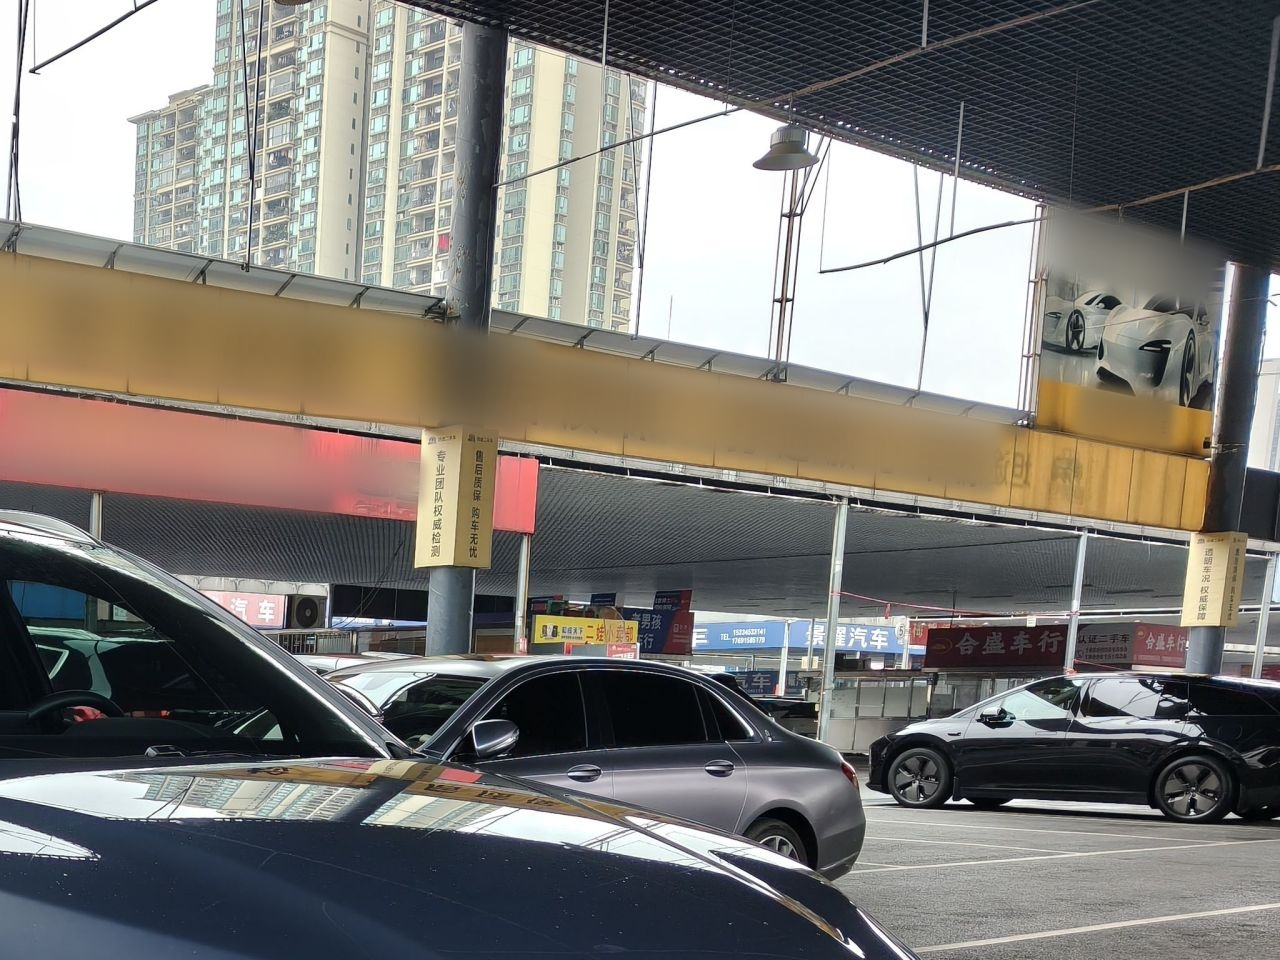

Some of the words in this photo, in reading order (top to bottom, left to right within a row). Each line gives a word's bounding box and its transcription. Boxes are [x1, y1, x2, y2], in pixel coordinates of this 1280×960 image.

[472, 449, 485, 502] 售后质保
[430, 450, 447, 558] 专业团队权威检测
[468, 506, 481, 558] 购车无忧
[585, 624, 635, 643] 二娃小卖部
[955, 630, 1064, 656] 合盛车行
[1146, 632, 1186, 652] 合盛车行
